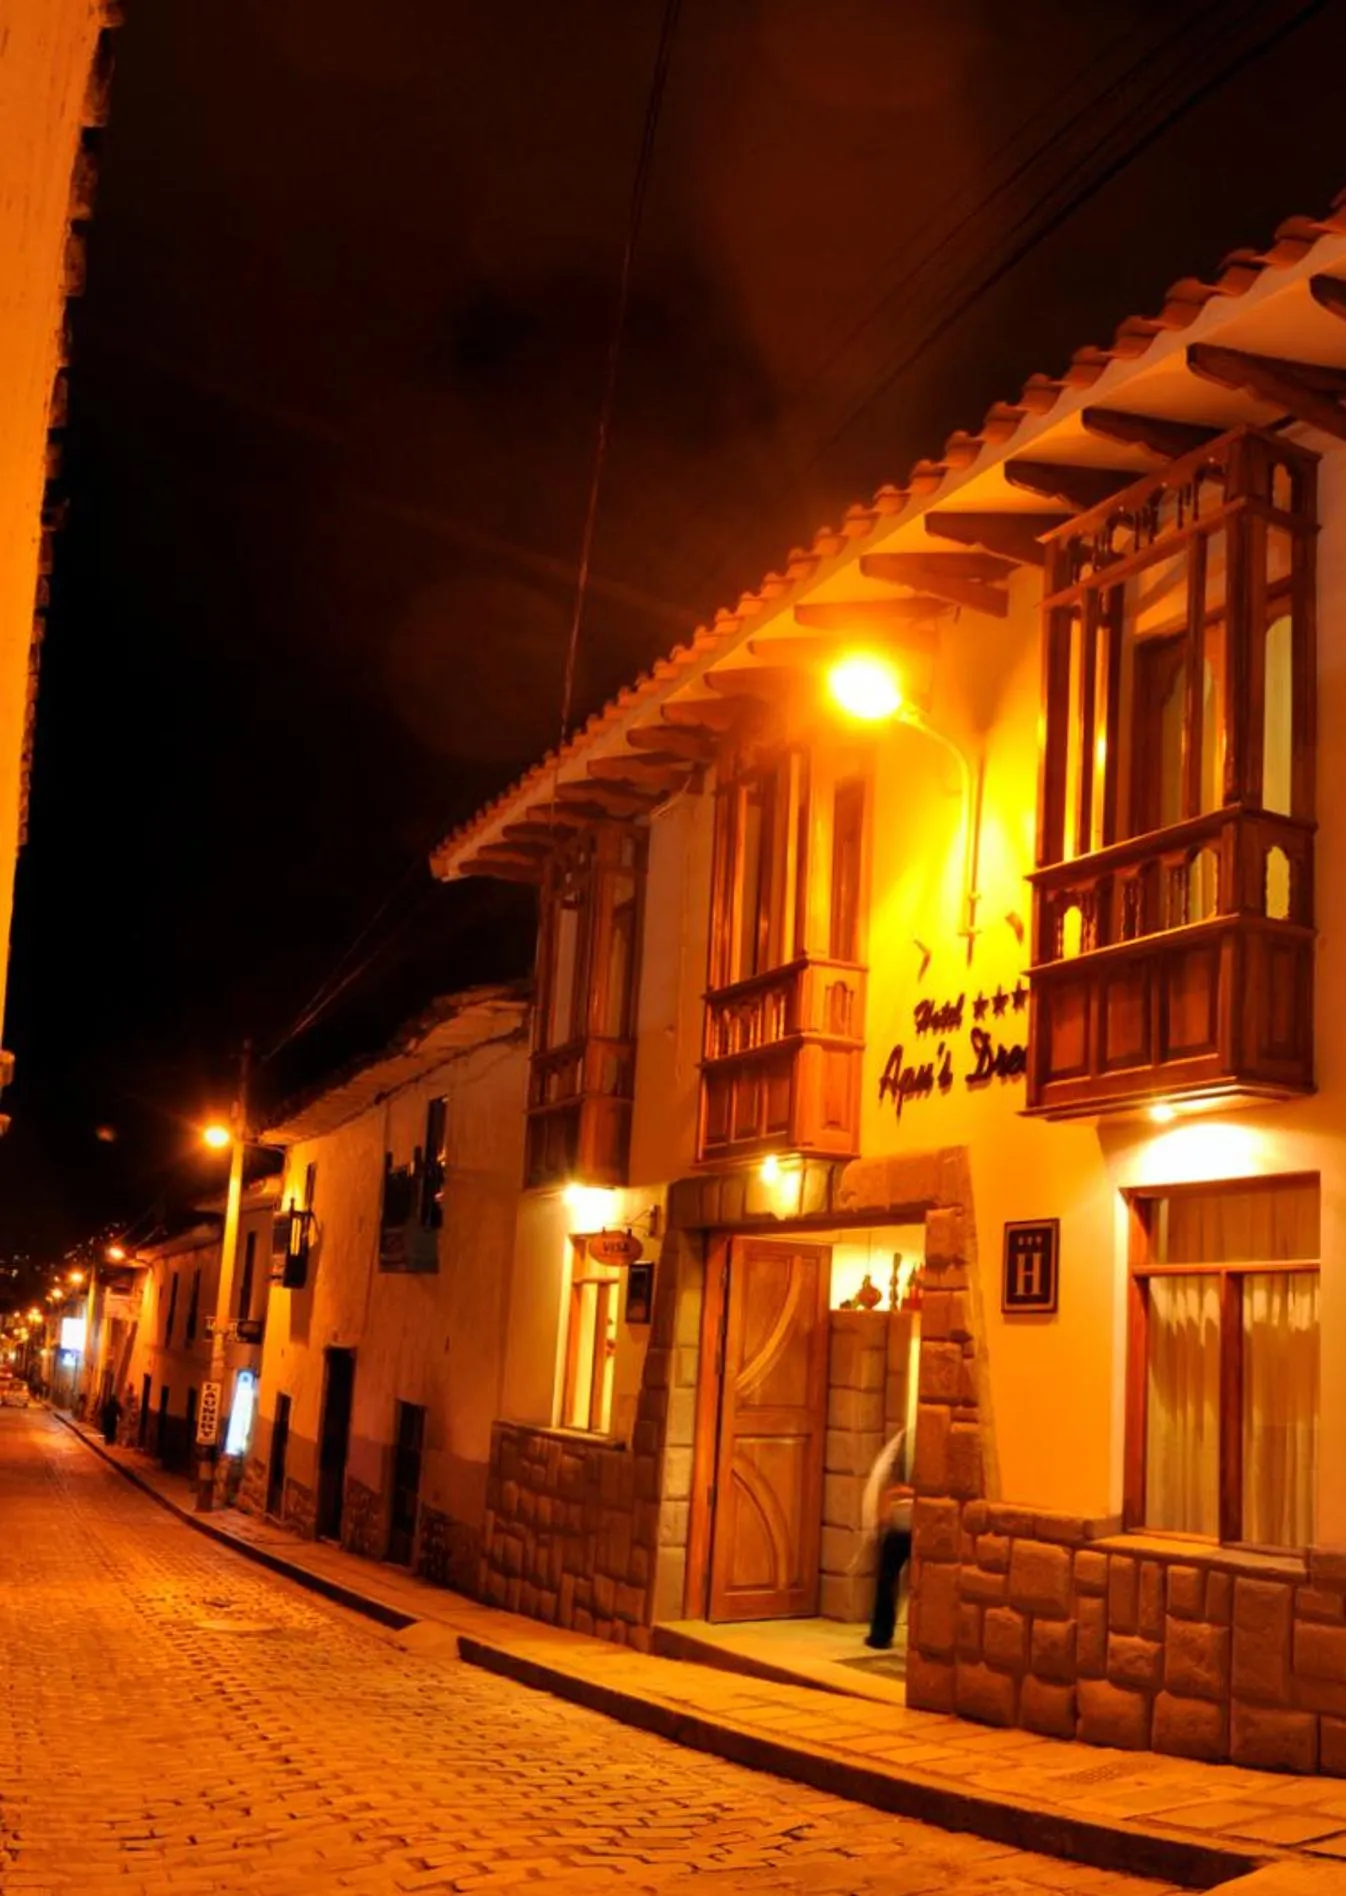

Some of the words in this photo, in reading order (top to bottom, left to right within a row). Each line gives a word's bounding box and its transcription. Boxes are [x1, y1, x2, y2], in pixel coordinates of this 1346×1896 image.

[914, 993, 964, 1034] Hotel
[879, 1041, 953, 1120] Apu's
[1014, 1252, 1042, 1296] H
